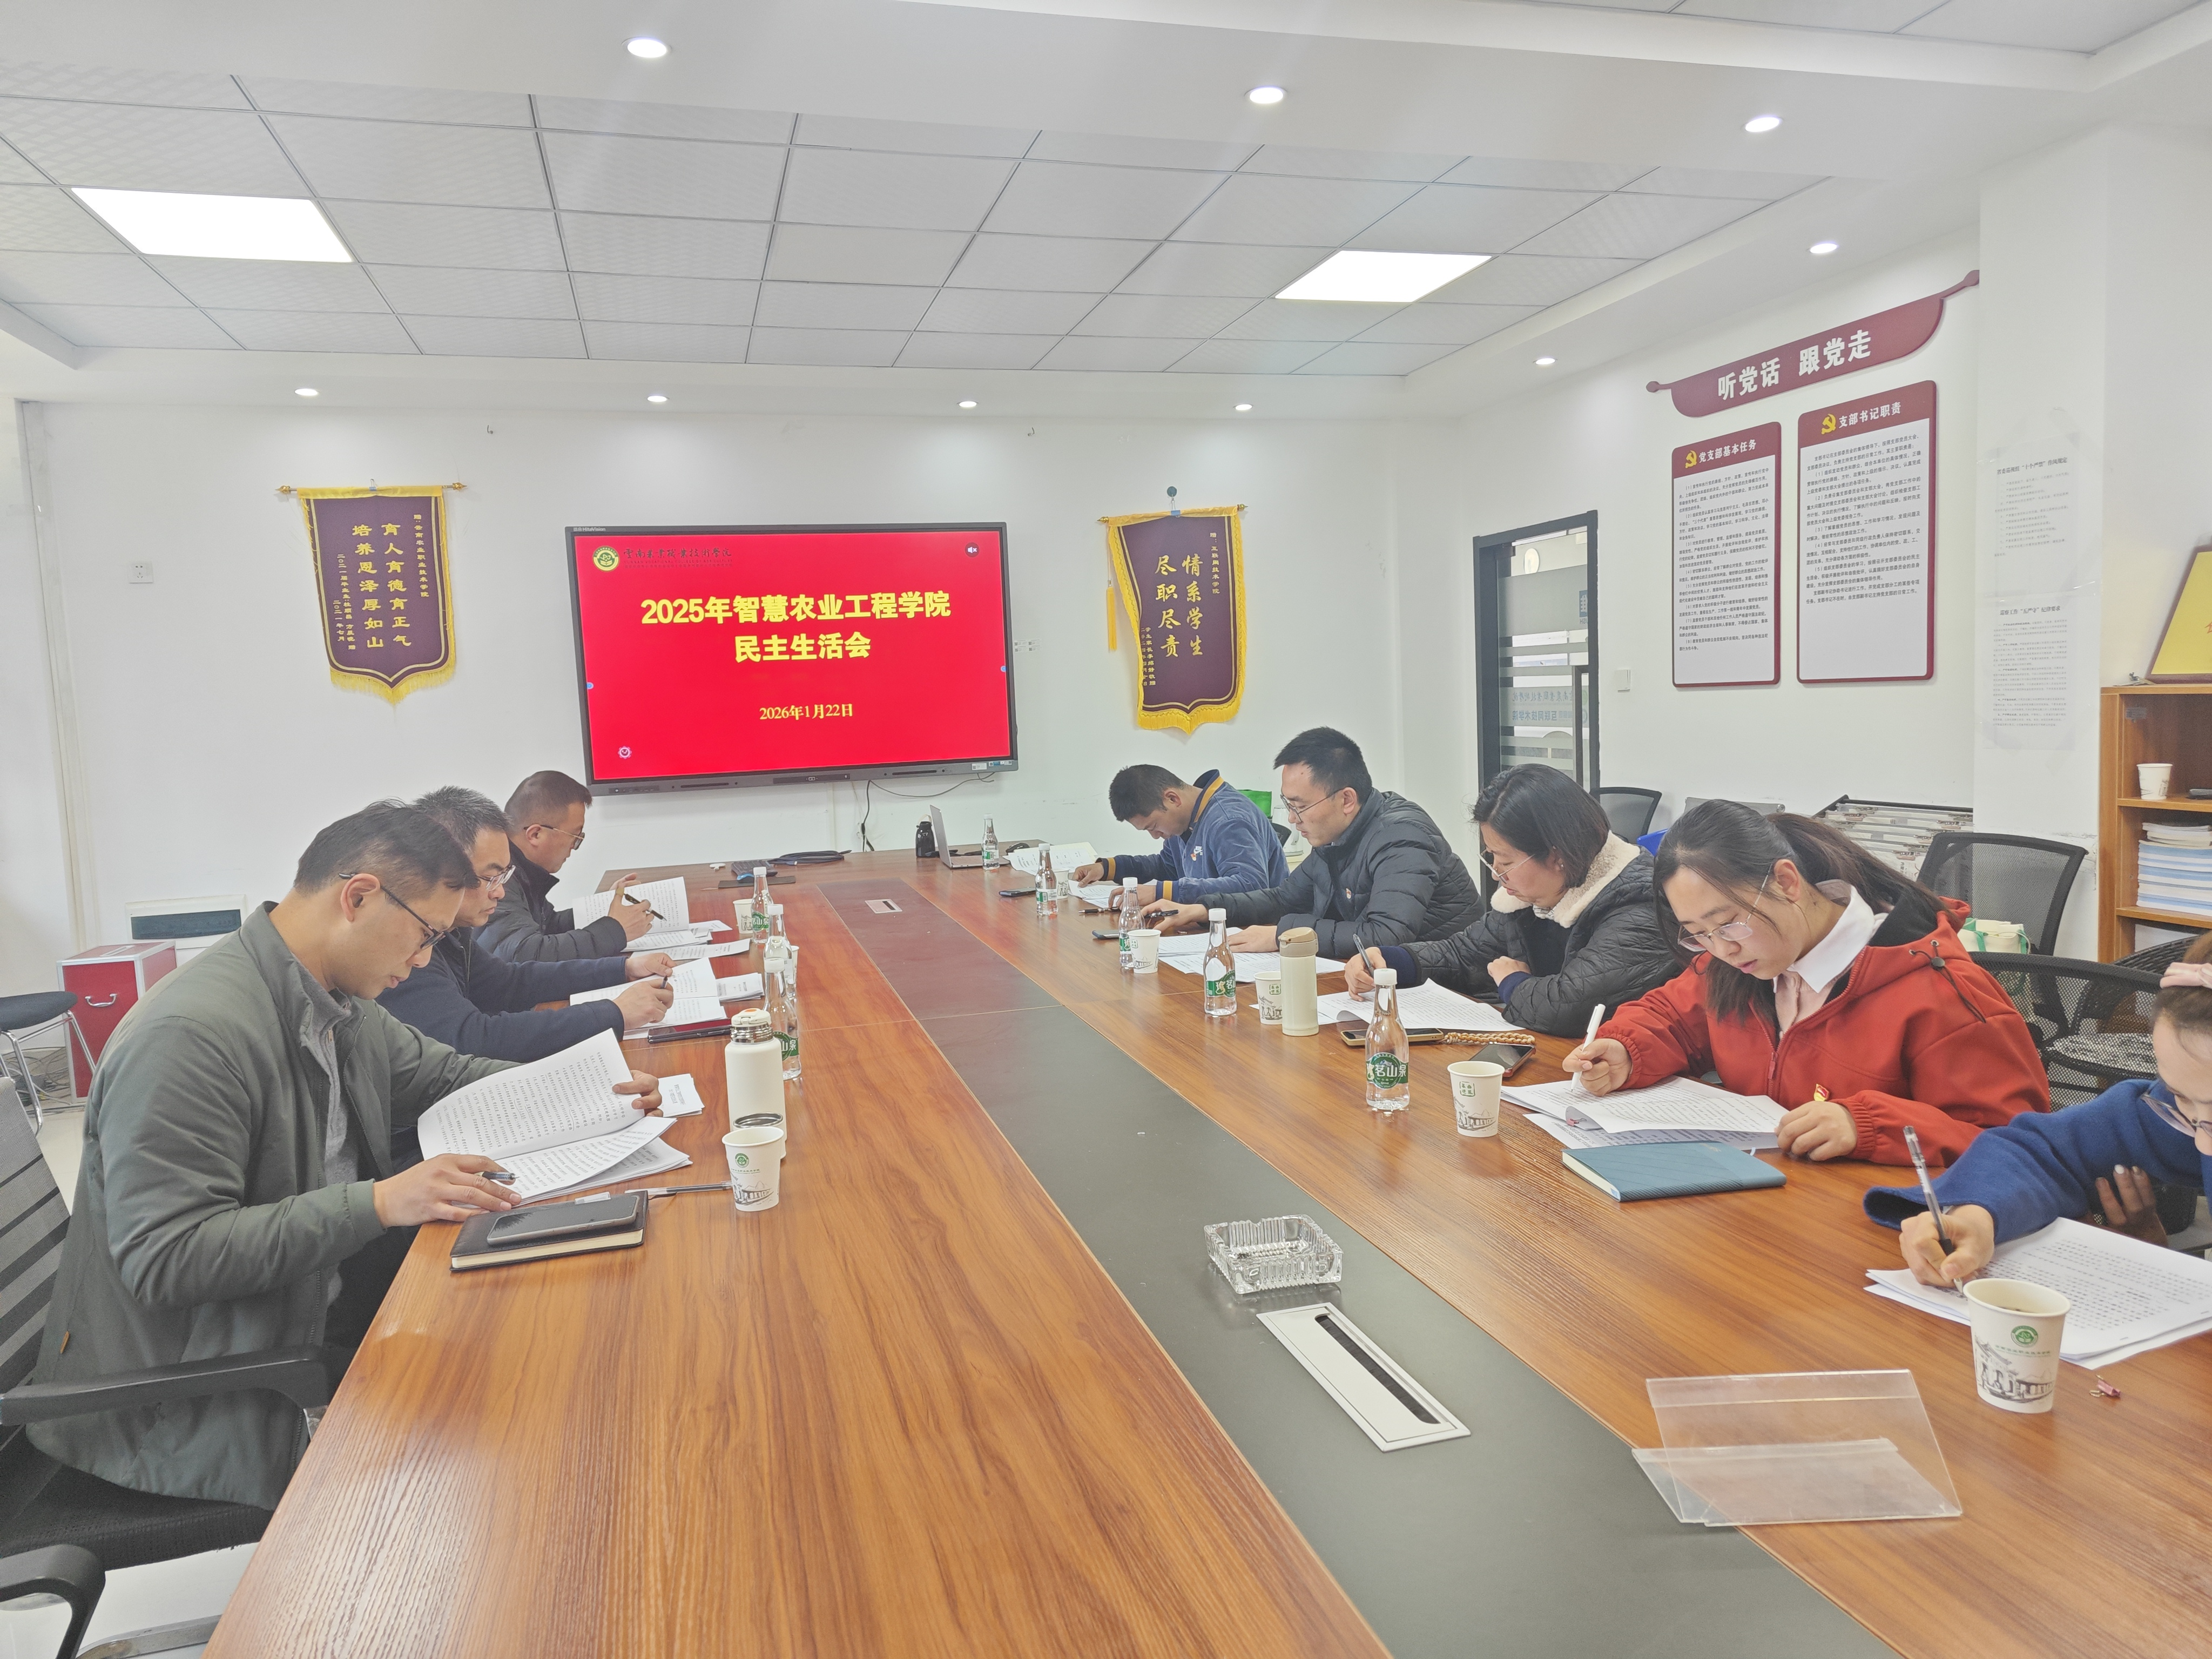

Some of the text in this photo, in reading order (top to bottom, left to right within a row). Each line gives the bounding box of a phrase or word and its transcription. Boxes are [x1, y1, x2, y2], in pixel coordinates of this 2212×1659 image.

[1717, 329, 1871, 401] 听党话 跟党走
[1838, 402, 1901, 428] 支部书记职责
[1699, 439, 1757, 463] 党支部基本任务
[352, 524, 384, 648] 培养恩泽厚如山
[381, 523, 412, 647] 育人育德育正气
[640, 590, 952, 624] 2025年智慧农业工程学院
[1155, 555, 1181, 657] 尽职尽责
[1182, 554, 1204, 656] 情系学生
[734, 631, 871, 663] 民主生活会
[759, 703, 853, 721] 2026年1月22日
